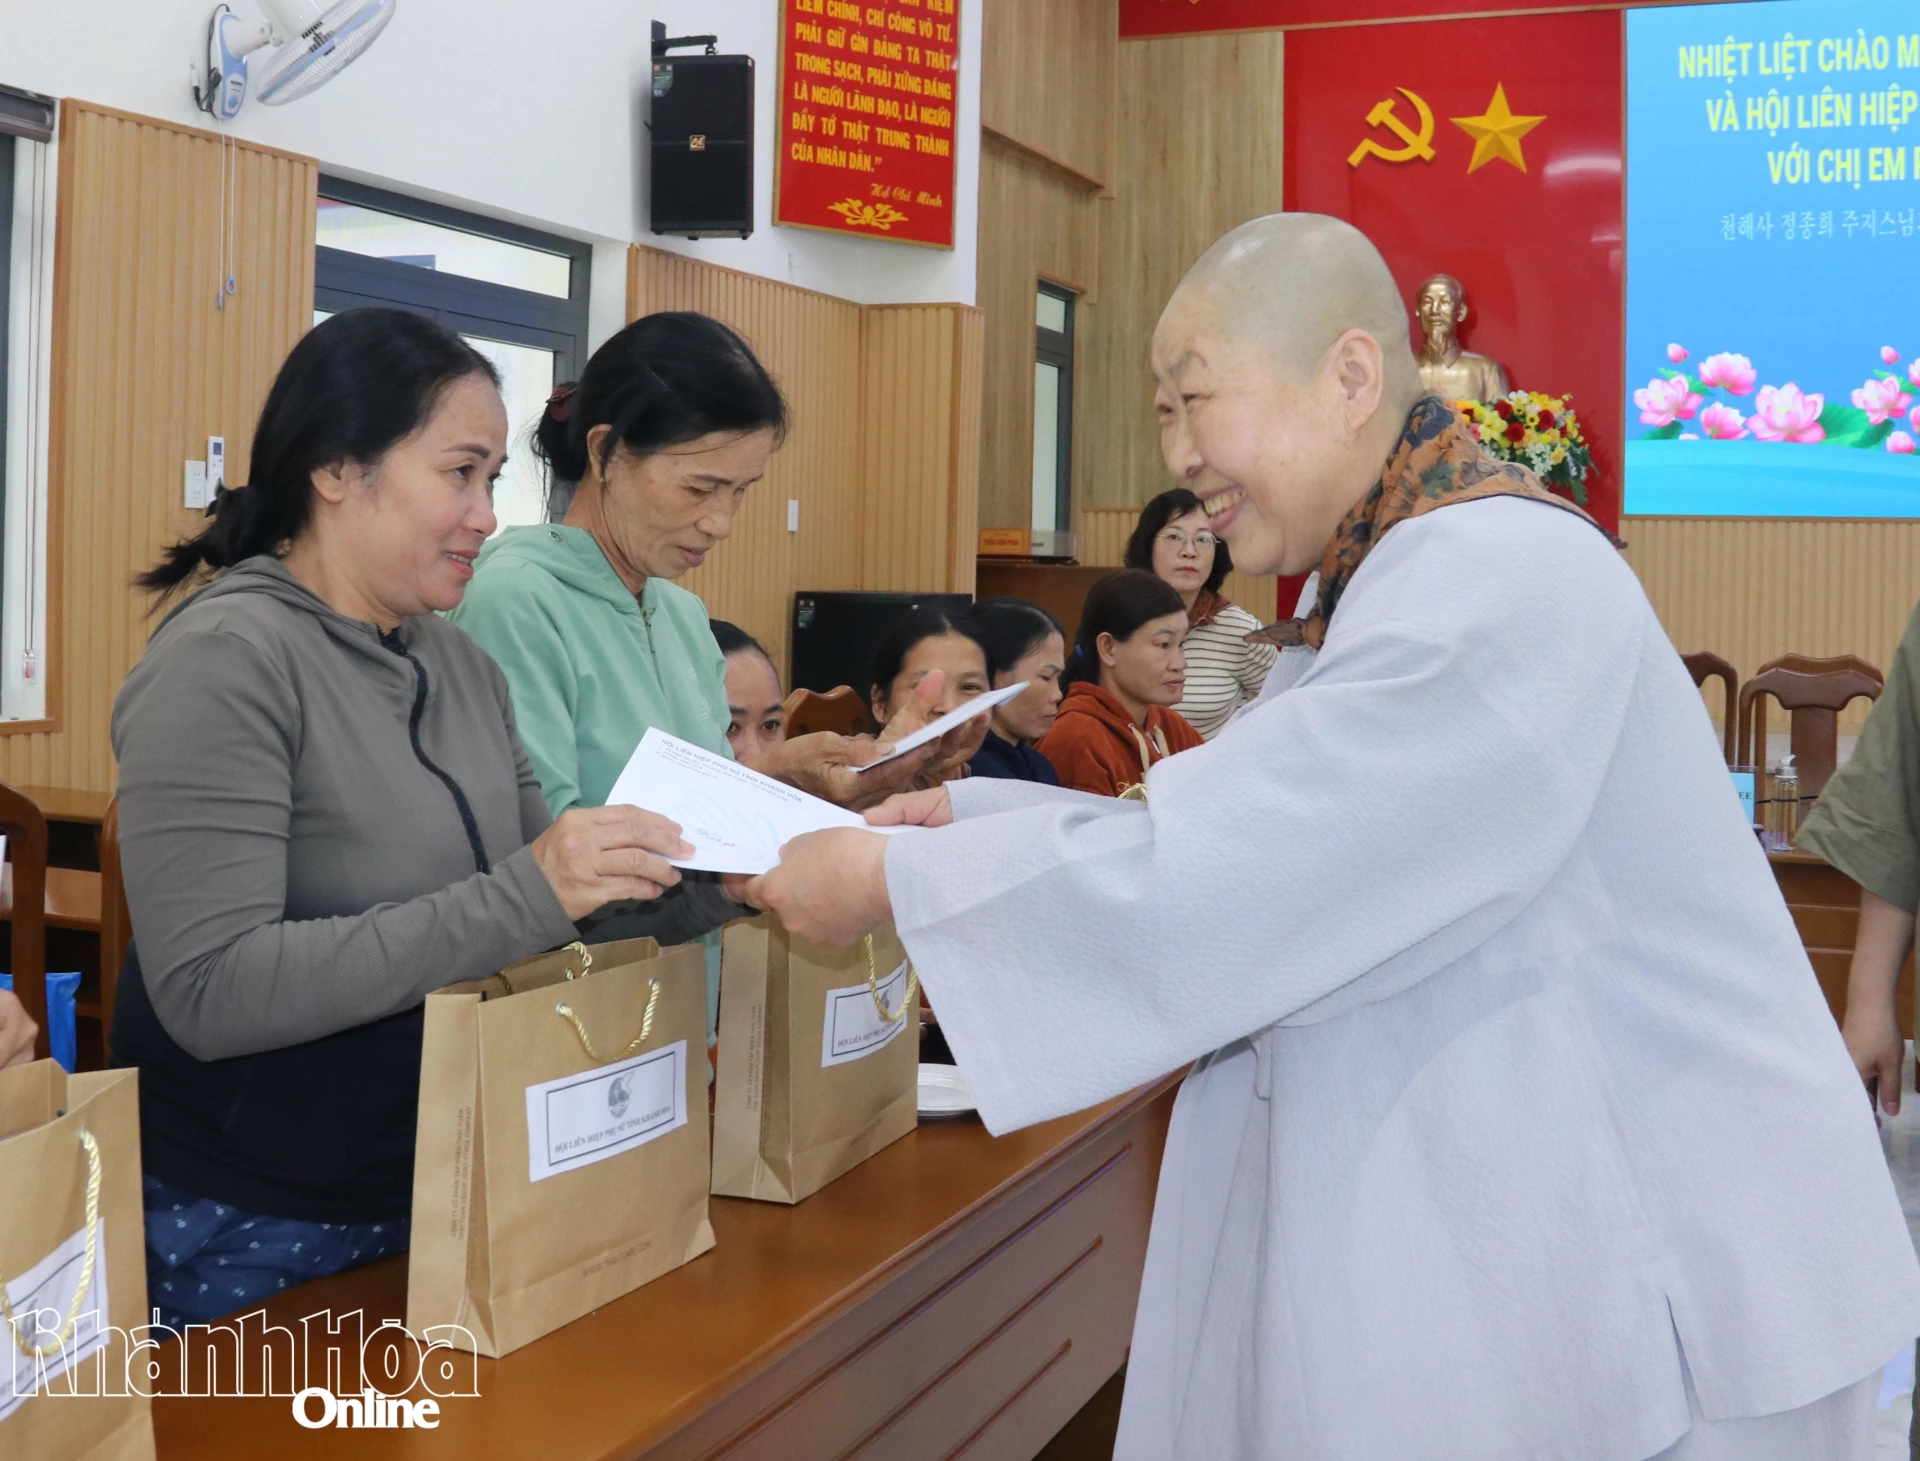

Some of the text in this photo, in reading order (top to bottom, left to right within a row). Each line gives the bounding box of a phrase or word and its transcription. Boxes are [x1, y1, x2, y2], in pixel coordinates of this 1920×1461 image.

[827, 0, 862, 25] CHÍNH,
[866, 8, 885, 28] CHÍ
[888, 11, 916, 35] CÔNG
[919, 18, 934, 38] VÔ
[795, 19, 952, 73] PHẢI GIỮ GÌN ĐẢNG TA THẬT
[1678, 35, 1753, 84] NHIỆT
[1759, 31, 1813, 81] LIỆT
[1818, 28, 1889, 73] CHÀO
[795, 52, 952, 101] TRONG SẠCH, PHẢI XỨNG ĐÁNG
[794, 80, 952, 129] LÀ NGƯỜI LÃNH ĐẠO, LÀ NGƯỜI
[1706, 82, 1918, 137] VÀ HỘI LIÊN HIỆP
[791, 137, 814, 163] CỦA
[817, 145, 847, 168] NHÂN
[821, 113, 837, 137] TỚ
[842, 120, 870, 145] THẬT
[876, 127, 911, 150] TRUNG
[915, 133, 950, 157] THÀNH
[1767, 141, 1810, 184] VỚI
[1817, 148, 1861, 190] CHỊ
[1868, 146, 1906, 182] EM
[1780, 210, 1833, 240] 정종희
[1841, 207, 1920, 239] 주지스님
